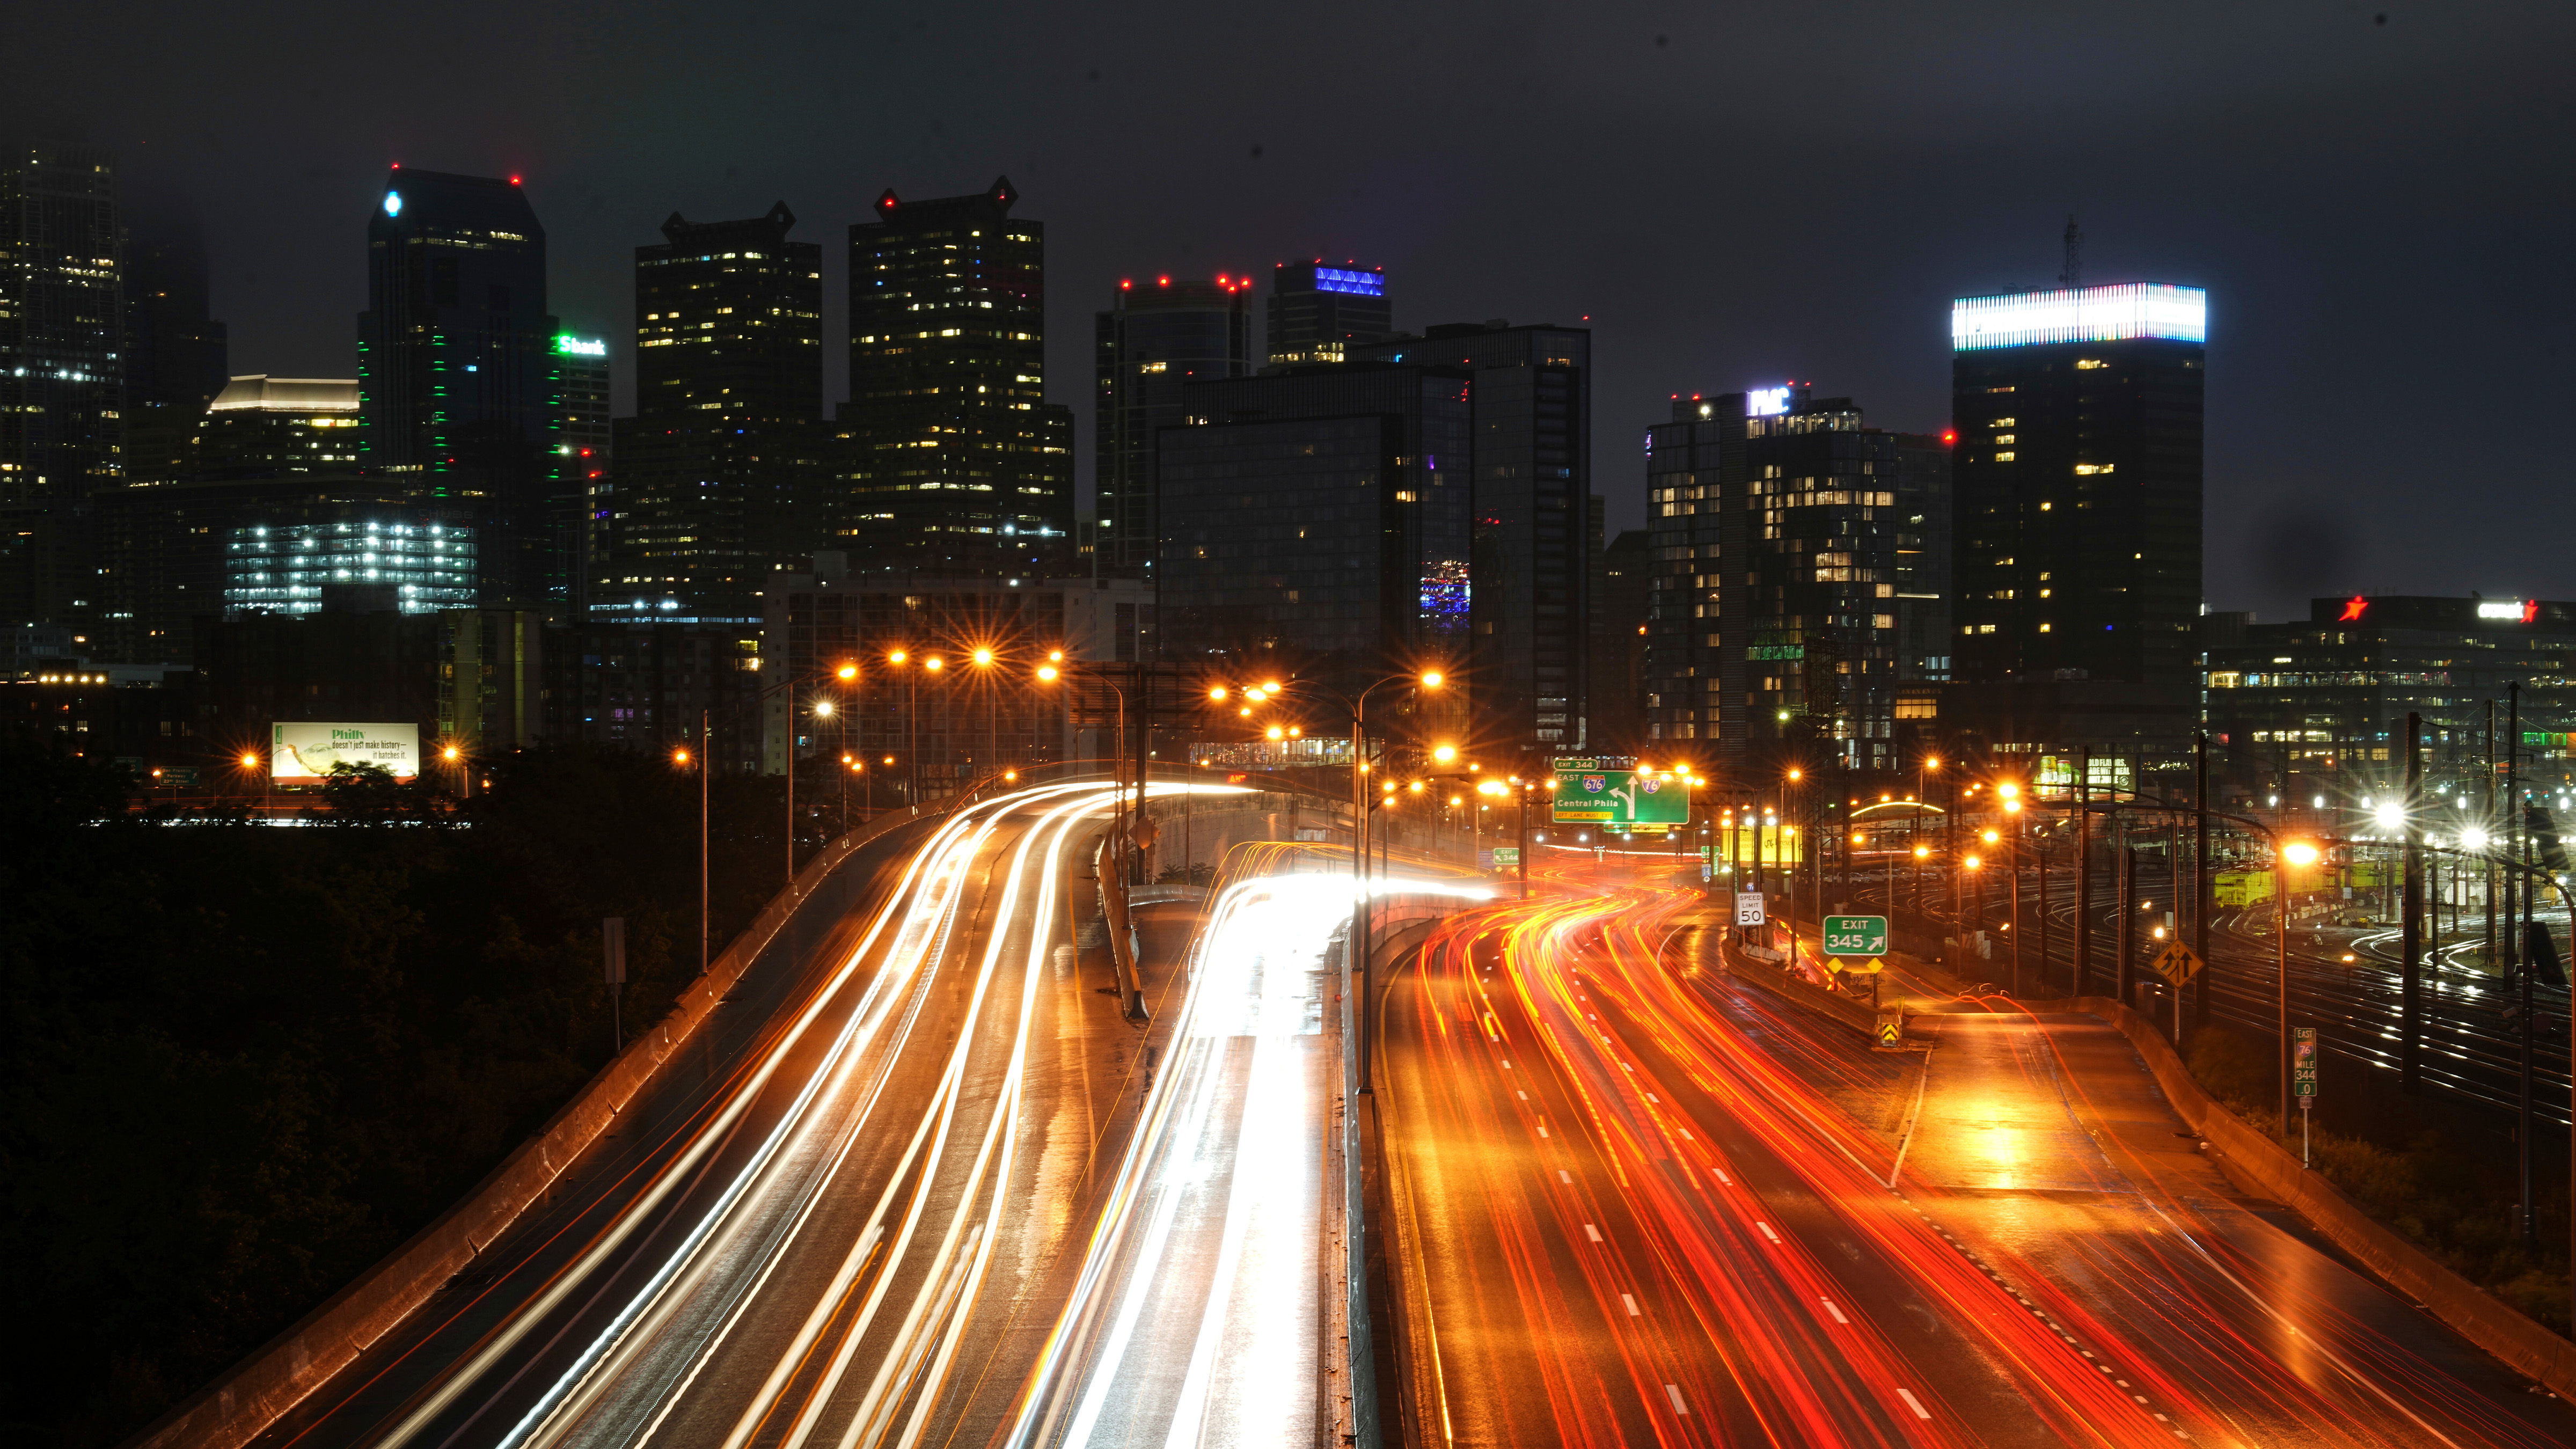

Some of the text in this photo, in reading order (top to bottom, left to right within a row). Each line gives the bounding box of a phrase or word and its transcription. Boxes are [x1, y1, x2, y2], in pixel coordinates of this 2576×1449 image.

[332, 729, 364, 743] Philly
[332, 741, 353, 749] doesn't
[353, 741, 364, 750] just
[365, 741, 380, 749] make
[373, 751, 377, 759] it
[378, 751, 400, 759] hatches
[1586, 780, 1602, 789] 676
[1644, 780, 1658, 791] 76
[1741, 911, 1761, 922] 50
[1842, 920, 1868, 930] EXIT
[1828, 934, 1863, 948] 345
[2297, 1030, 2312, 1038] EAST
[2299, 1045, 2311, 1054] 76
[2296, 1070, 2315, 1080] 344
[2301, 1084, 2311, 1094] .0
